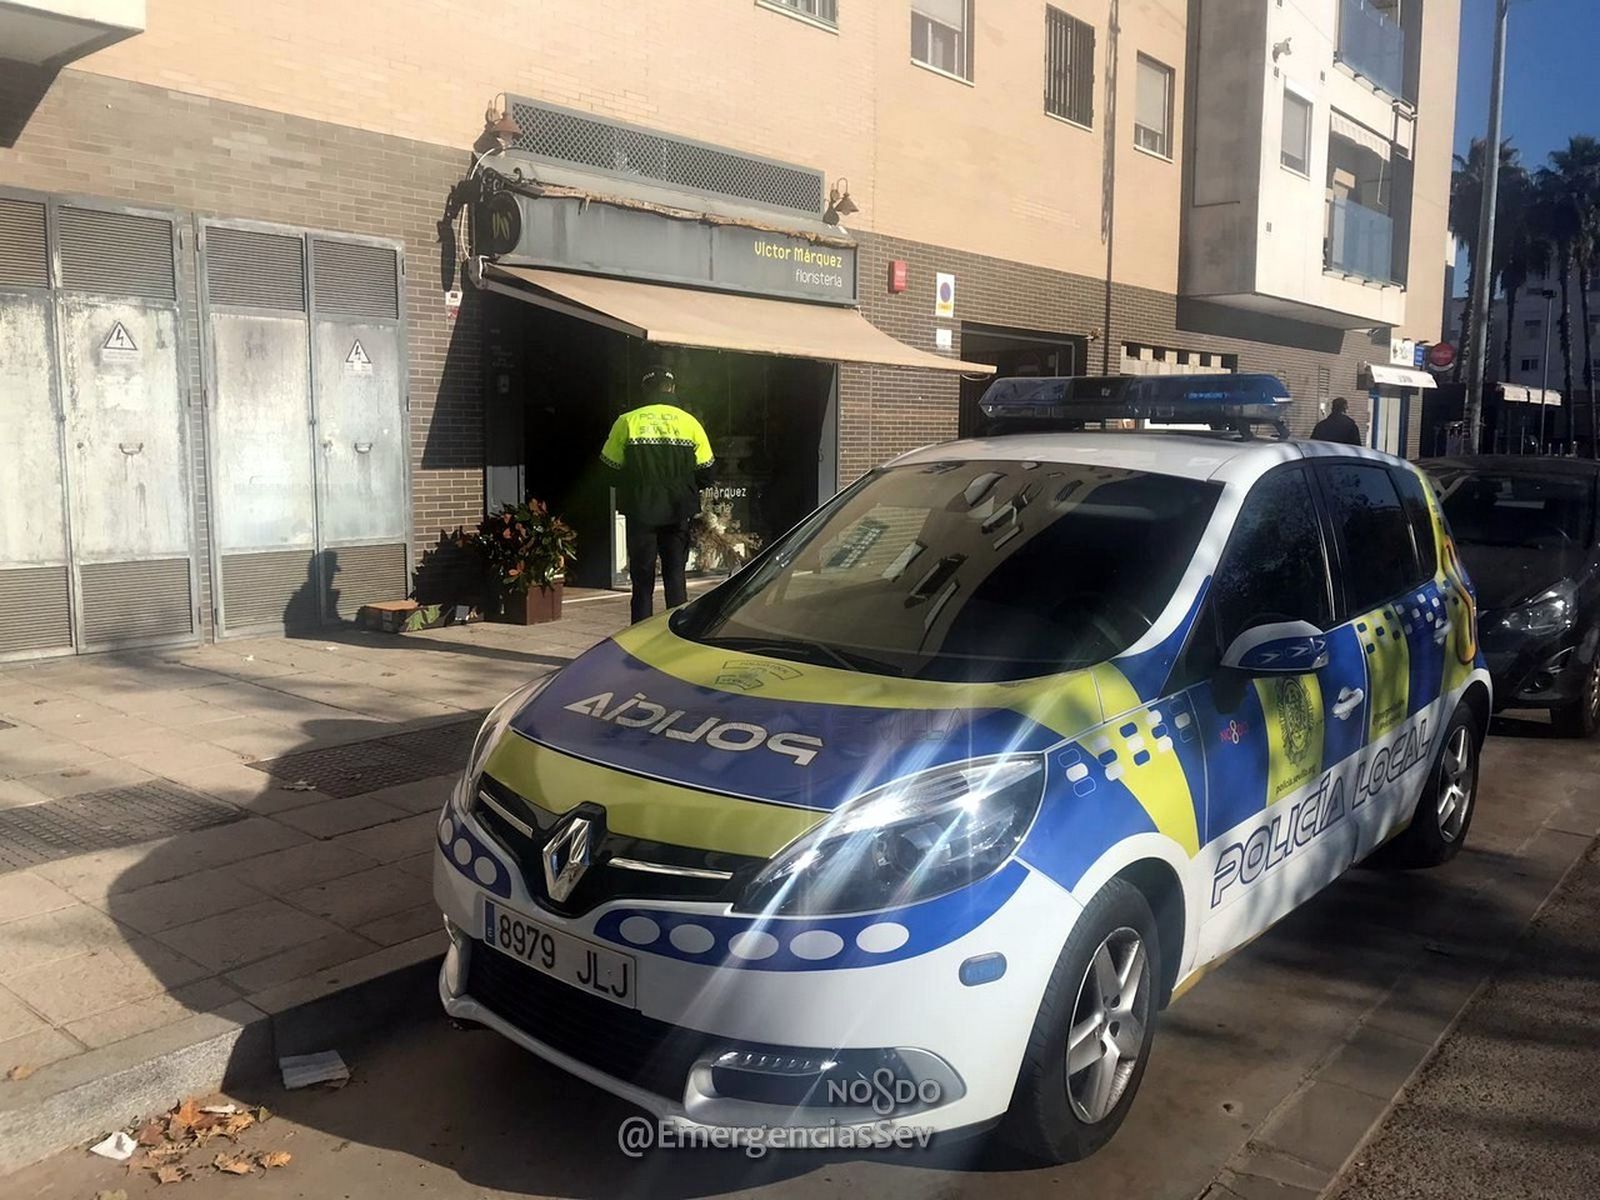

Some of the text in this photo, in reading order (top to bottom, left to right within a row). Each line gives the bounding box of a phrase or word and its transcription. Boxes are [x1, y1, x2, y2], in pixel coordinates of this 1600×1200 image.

[794, 247, 843, 269] Márquez
[1210, 718, 1433, 909] POLICÍA LOCAL
[500, 914, 628, 998] 8979 JLJ
